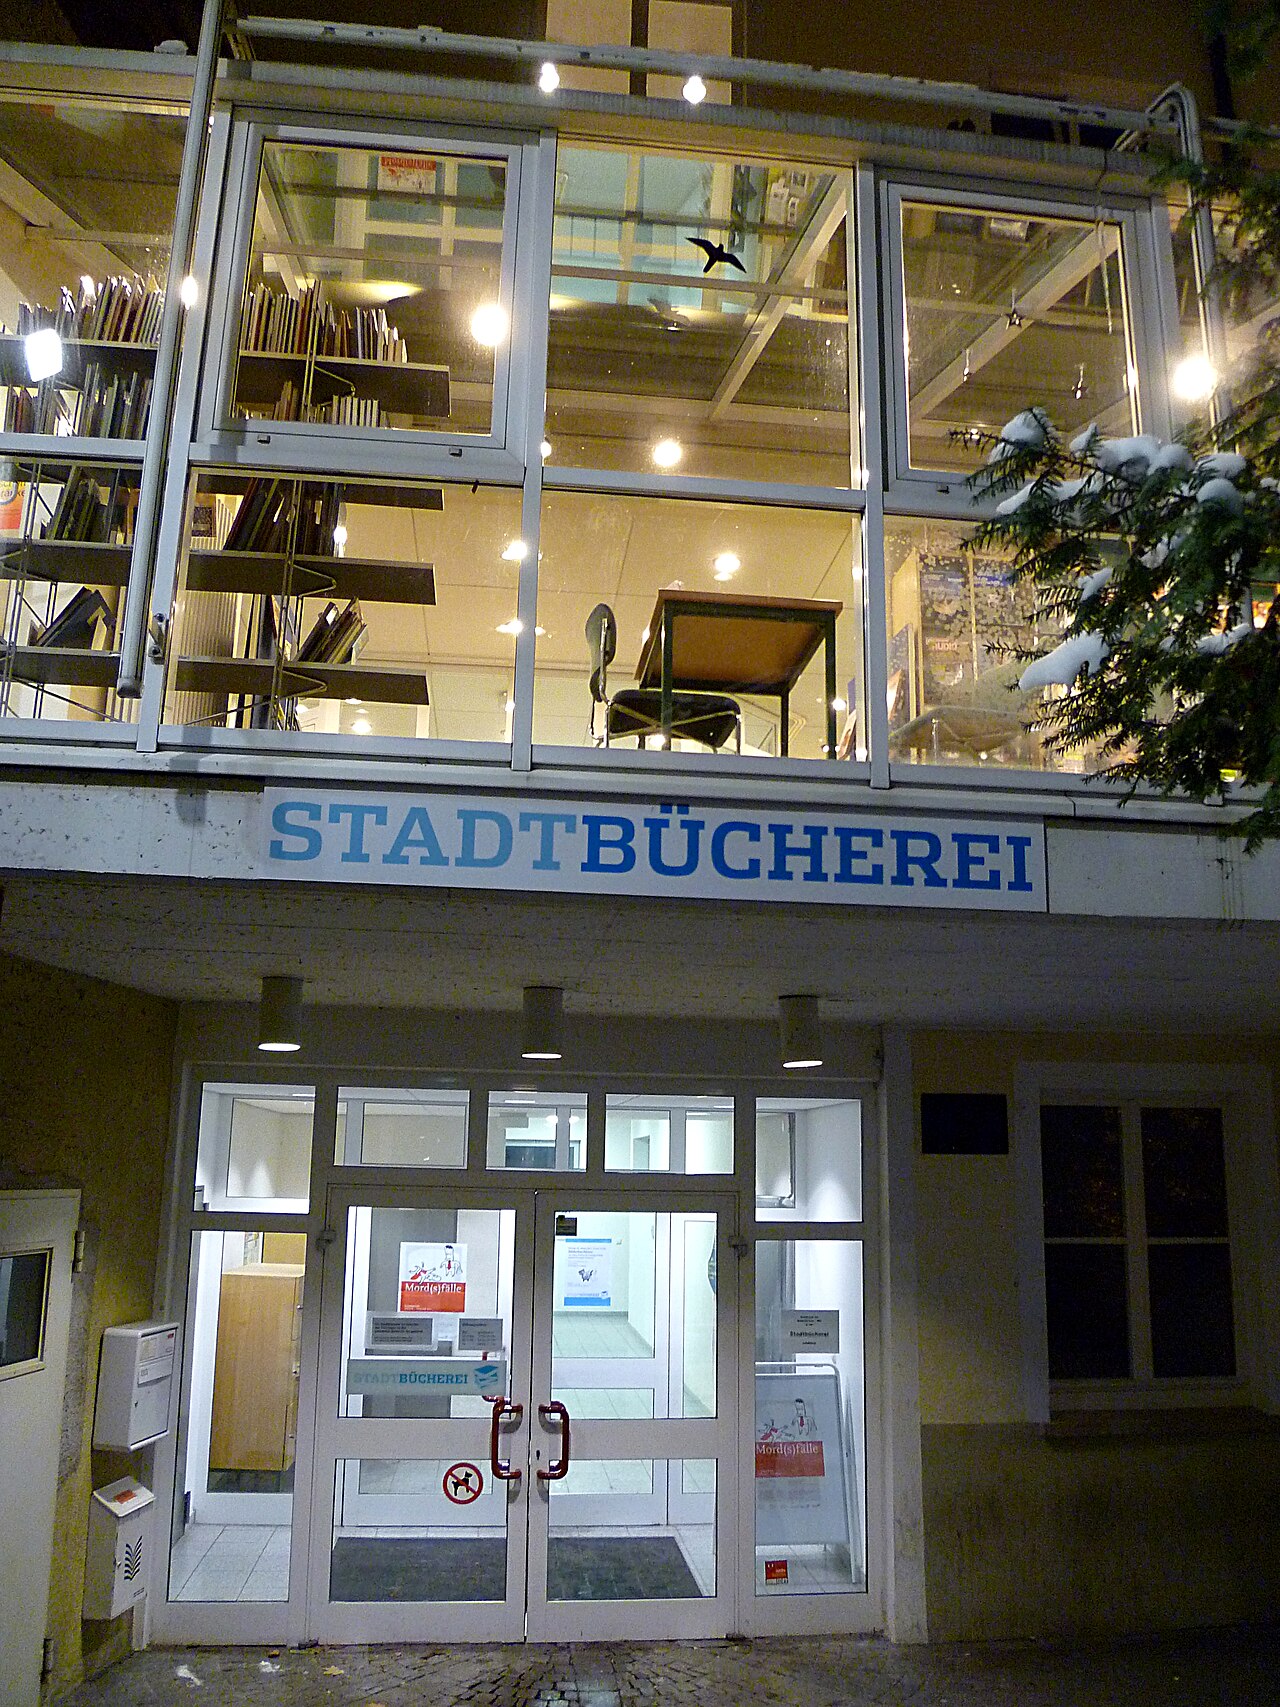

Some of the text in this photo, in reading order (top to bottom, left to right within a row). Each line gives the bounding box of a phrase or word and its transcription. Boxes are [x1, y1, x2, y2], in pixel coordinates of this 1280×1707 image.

[269, 801, 1033, 892] STADTBÜCHEREI
[405, 1283, 462, 1295] Mord(s)fälle
[353, 1371, 469, 1384] STADTBÜCHEREI
[755, 1443, 819, 1457] Mord(s)fälle
